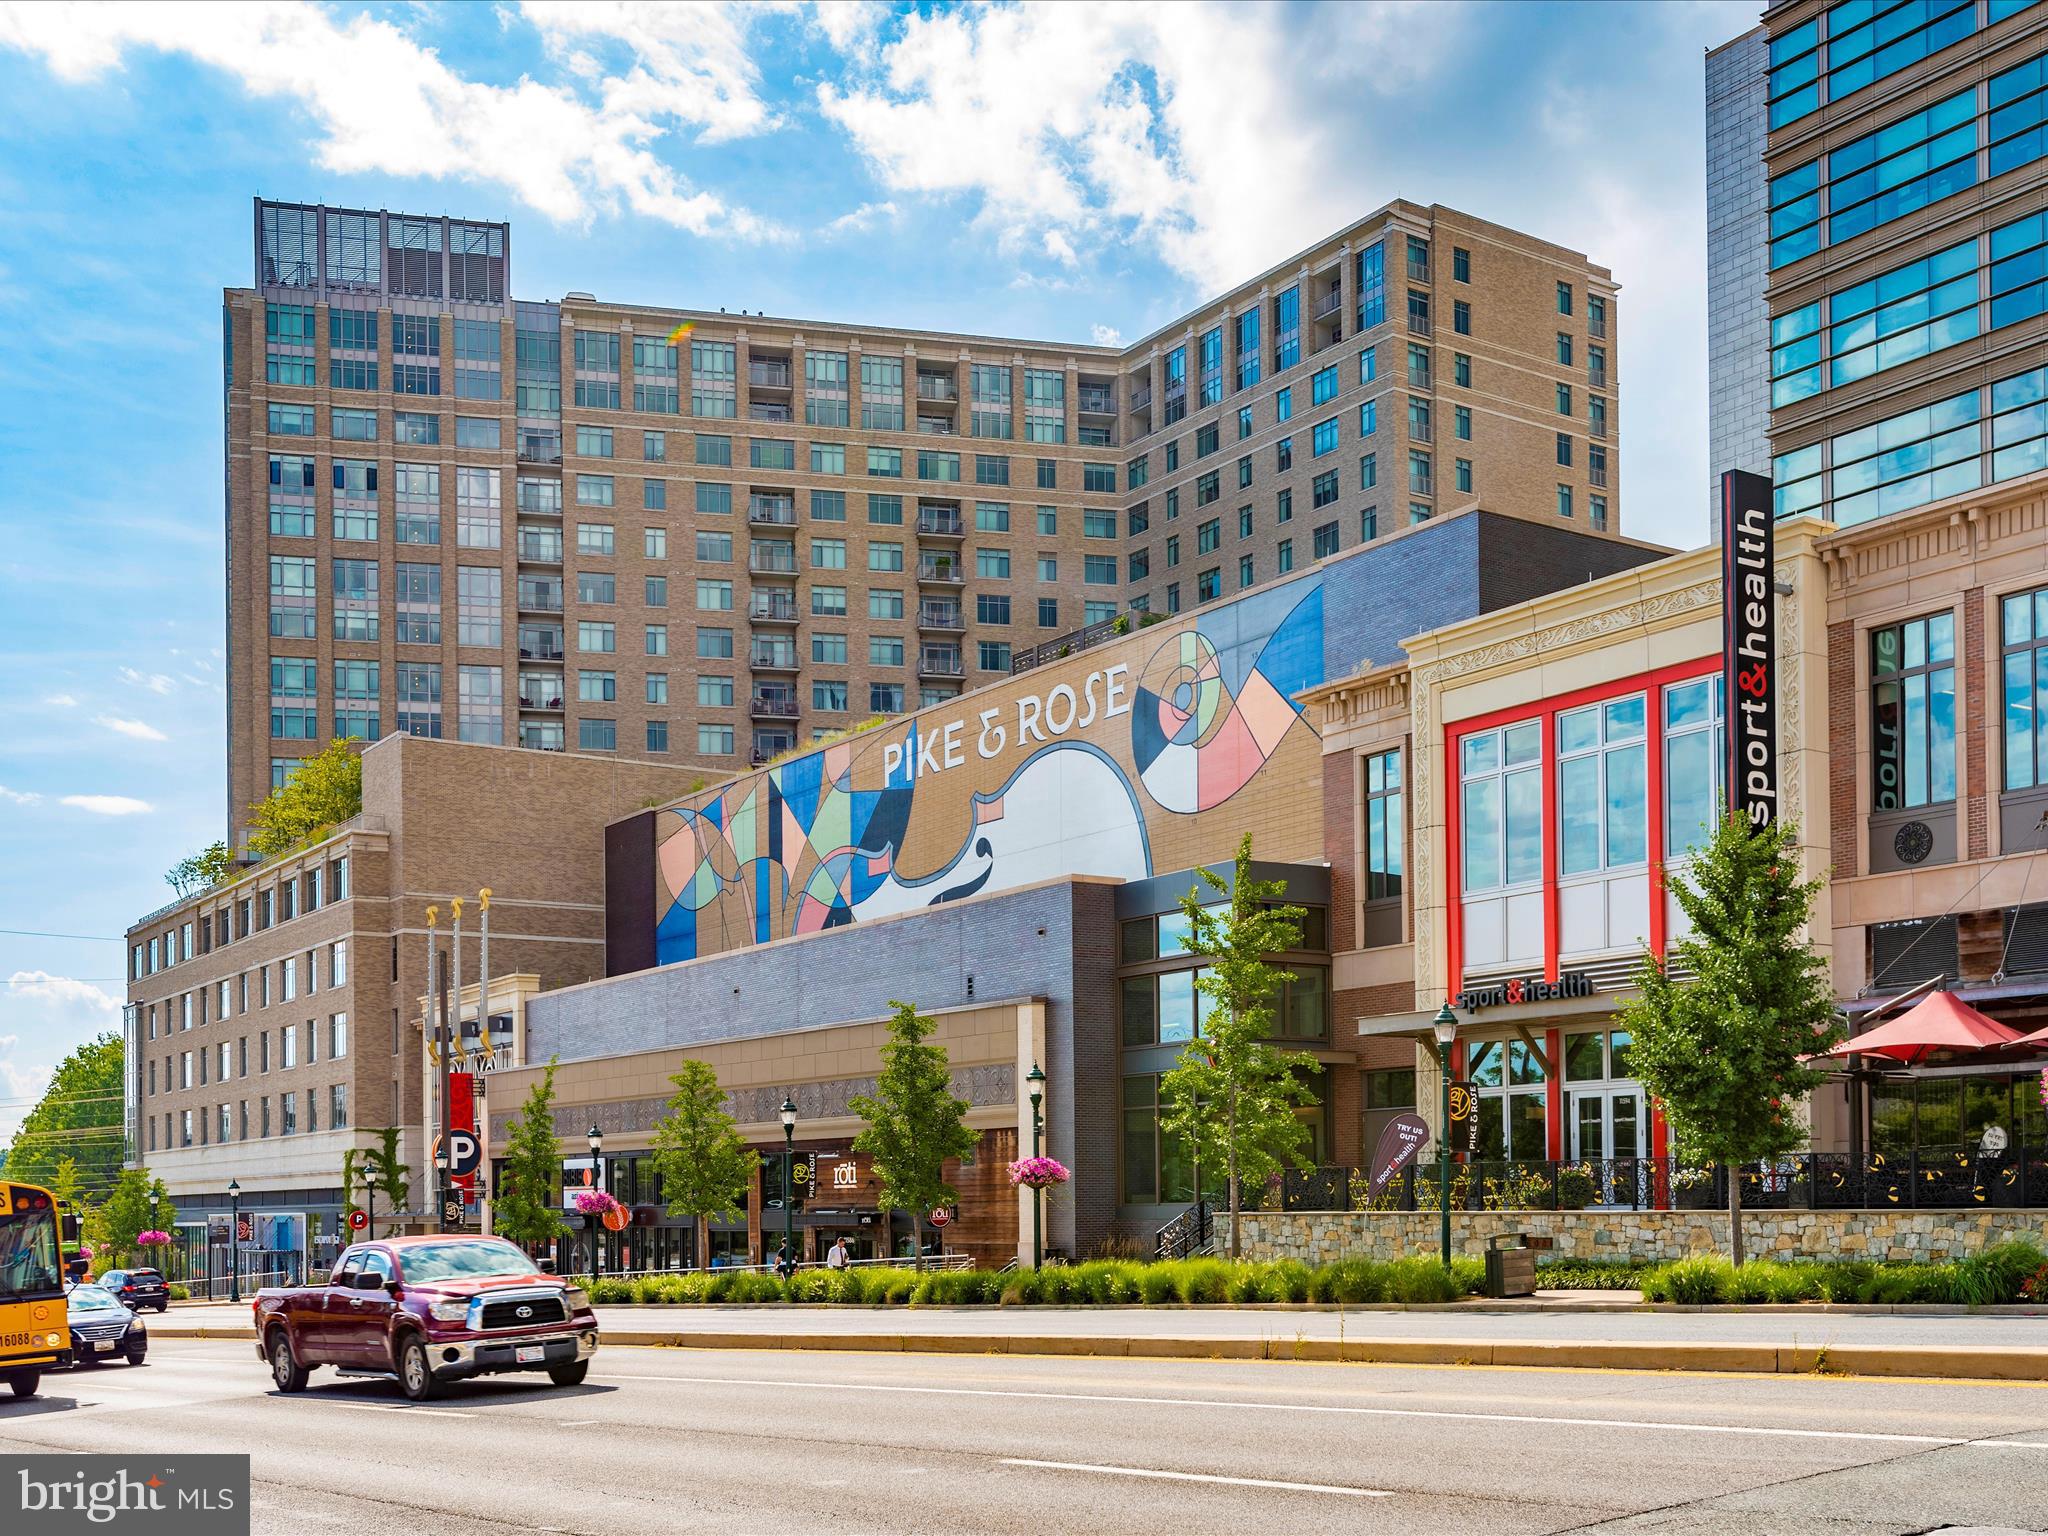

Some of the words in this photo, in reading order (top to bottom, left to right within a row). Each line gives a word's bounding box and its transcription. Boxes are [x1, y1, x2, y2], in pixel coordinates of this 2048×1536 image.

[1736, 508, 1769, 828] sport&health
[884, 719, 966, 789] PIKE
[977, 707, 1007, 760] &
[1015, 663, 1132, 748] ROSE
[1455, 972, 1596, 1014] sport&health
[1469, 1085, 1478, 1113] ROSE
[1397, 1123, 1412, 1133] TRY
[1412, 1127, 1424, 1135] US
[1399, 1133, 1418, 1142] OUT!
[1469, 1125, 1478, 1150] PIKE
[450, 1136, 475, 1170] P
[356, 1214, 363, 1223] P
